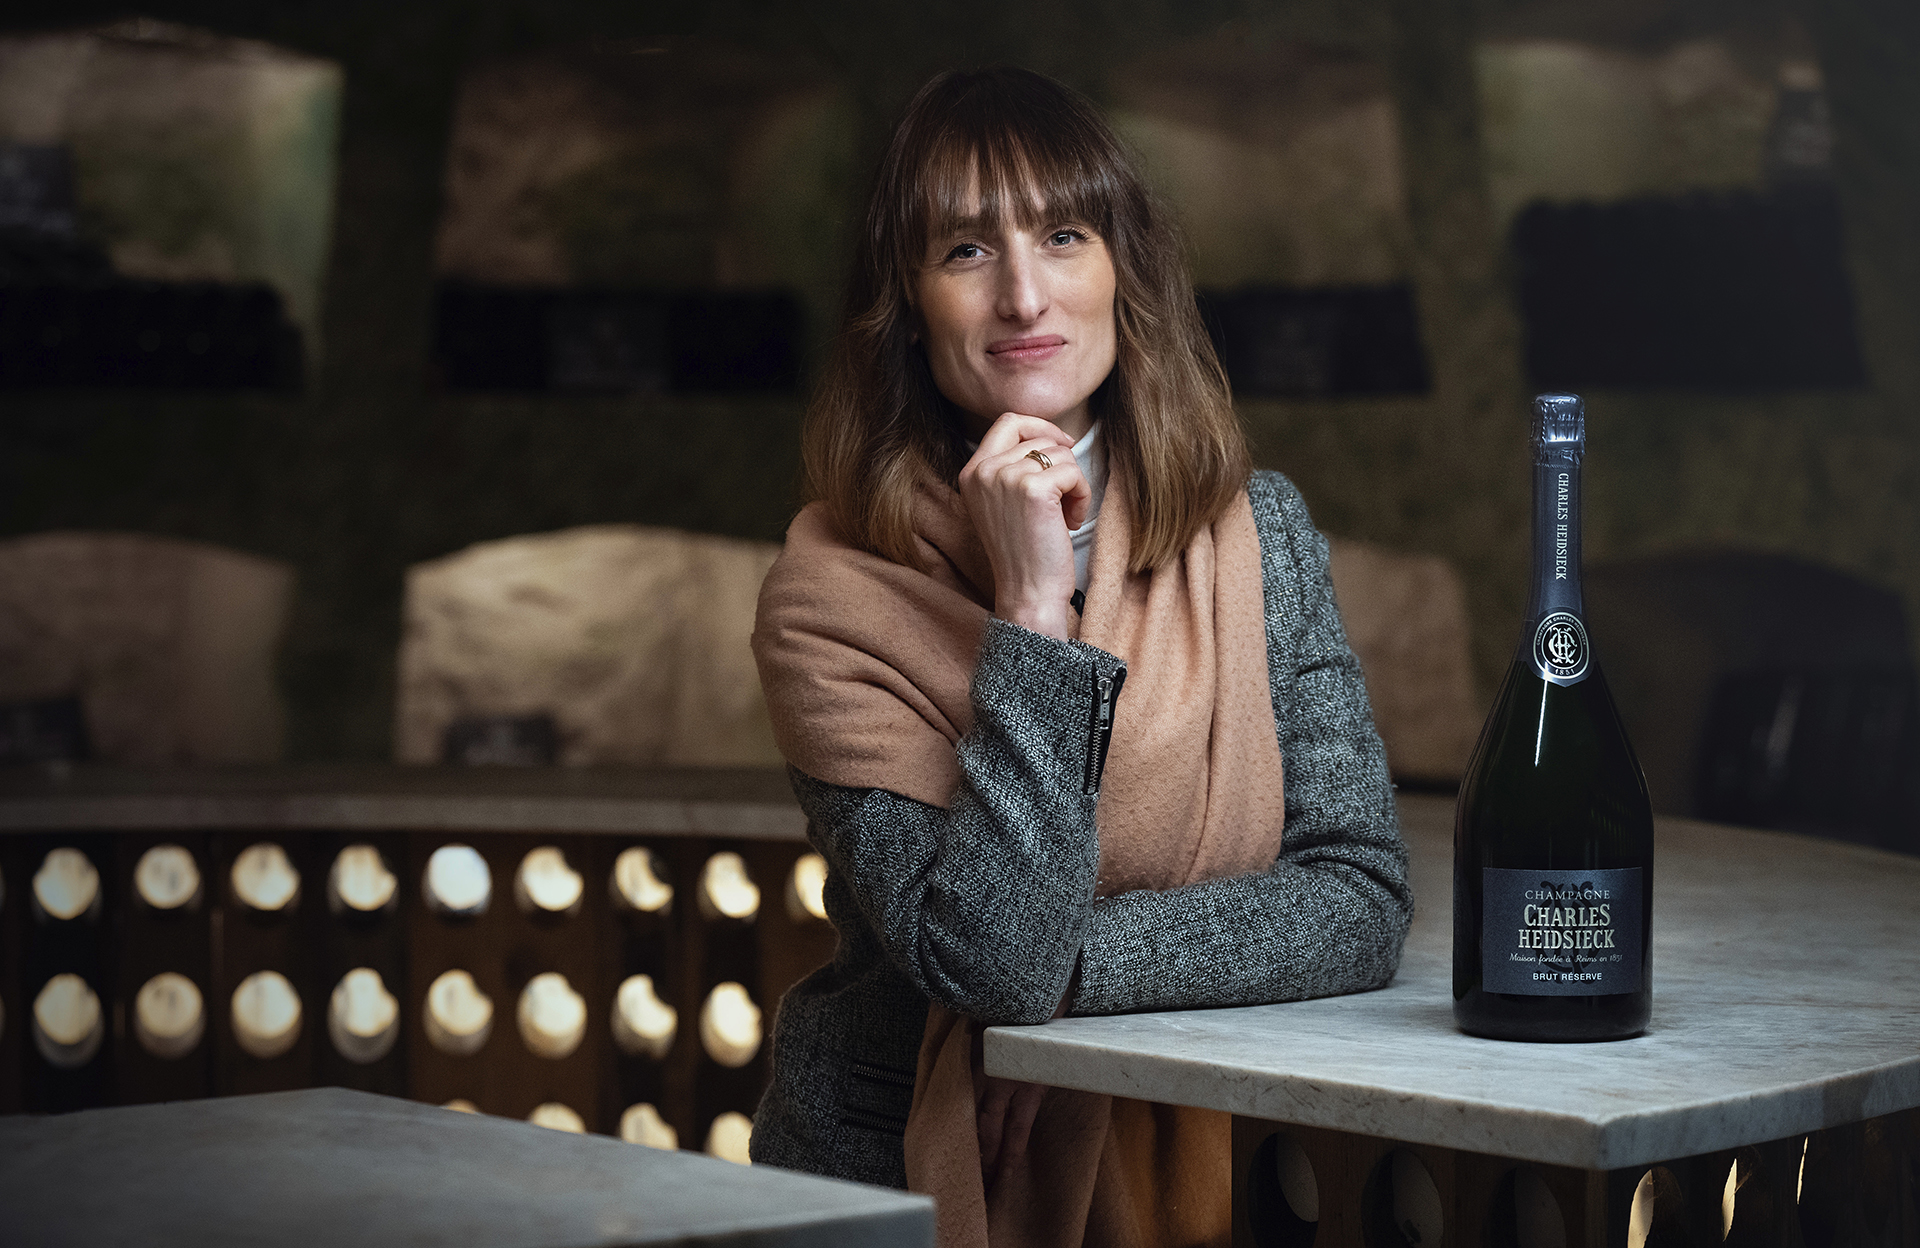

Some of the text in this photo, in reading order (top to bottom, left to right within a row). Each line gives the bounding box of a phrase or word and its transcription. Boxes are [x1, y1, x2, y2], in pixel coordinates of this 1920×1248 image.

[1556, 473, 1569, 580] CHARLES HEIDSIECK
[1555, 668, 1575, 676] 1851
[1524, 889, 1611, 900] CHAMPAGNE
[1523, 903, 1611, 927] CHARLES
[1518, 929, 1615, 949] HEIDSIECK
[1509, 953, 1536, 962] Maison
[1532, 971, 1603, 981] BRUT RÉSERVE
